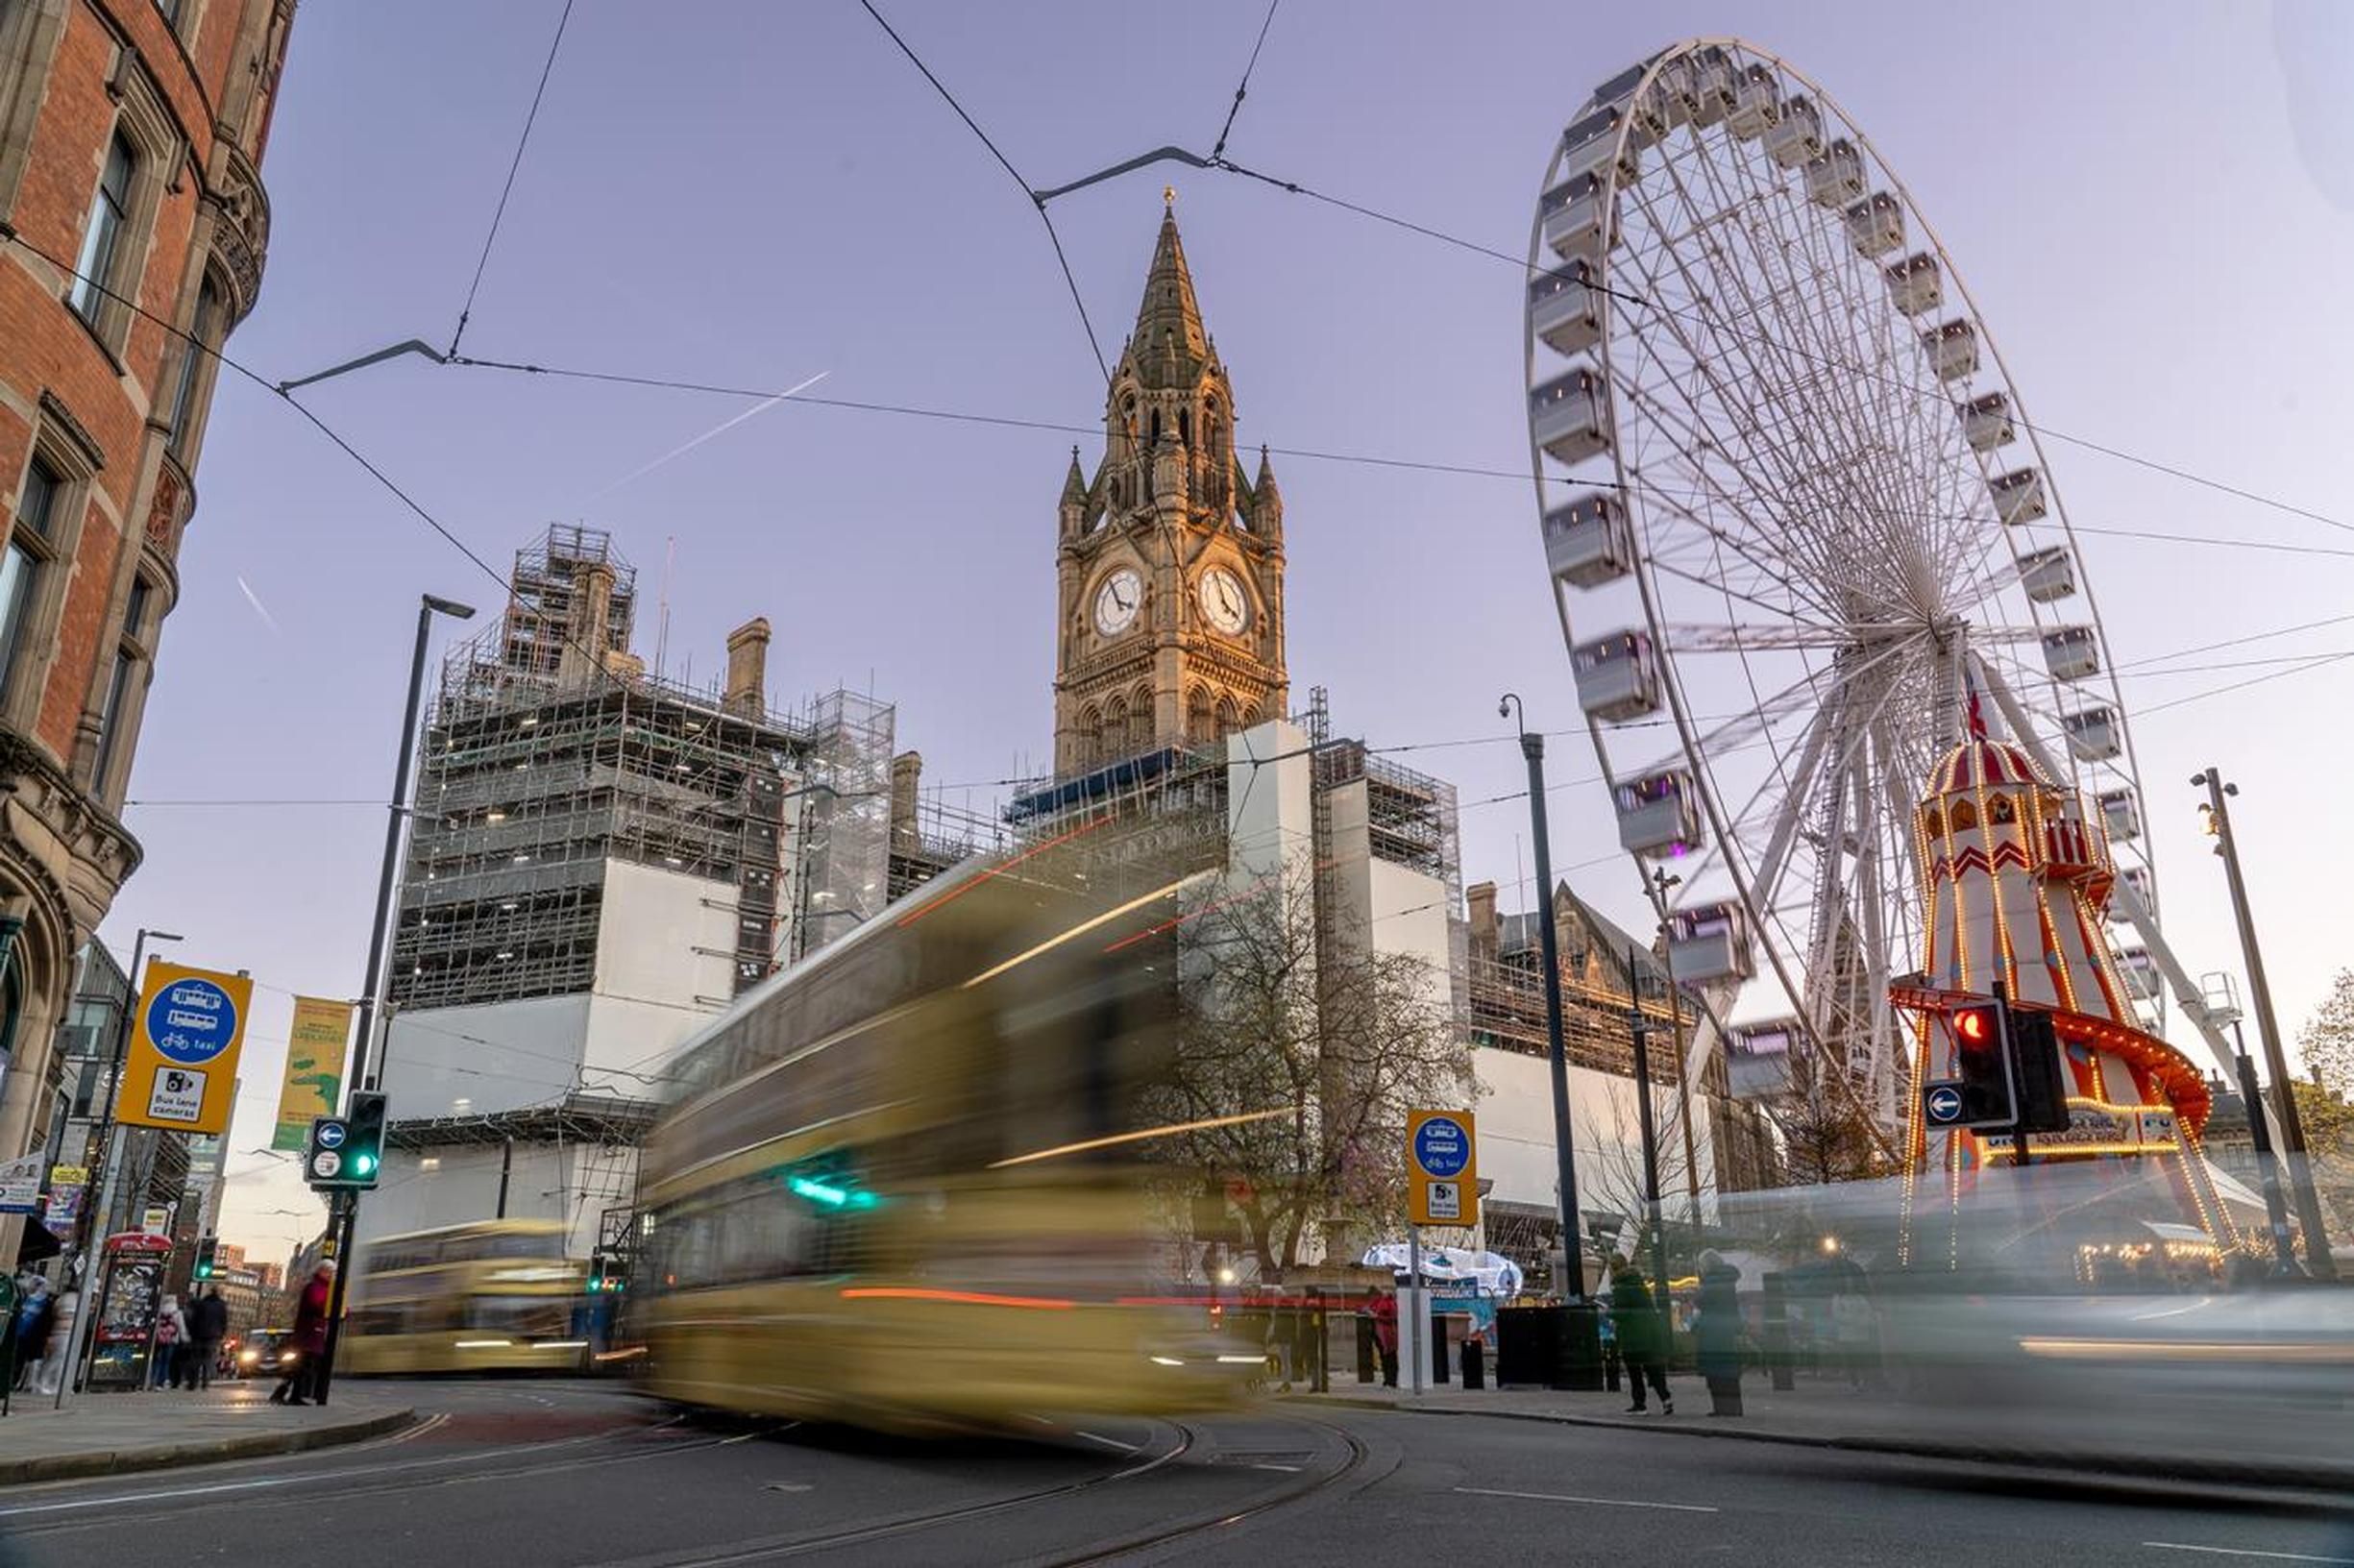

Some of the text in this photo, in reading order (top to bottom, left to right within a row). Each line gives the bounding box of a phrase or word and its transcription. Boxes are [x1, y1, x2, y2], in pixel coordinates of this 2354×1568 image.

[194, 1040, 216, 1051] taxi
[155, 1094, 198, 1108] Bus lane
[154, 1106, 195, 1117] cameras
